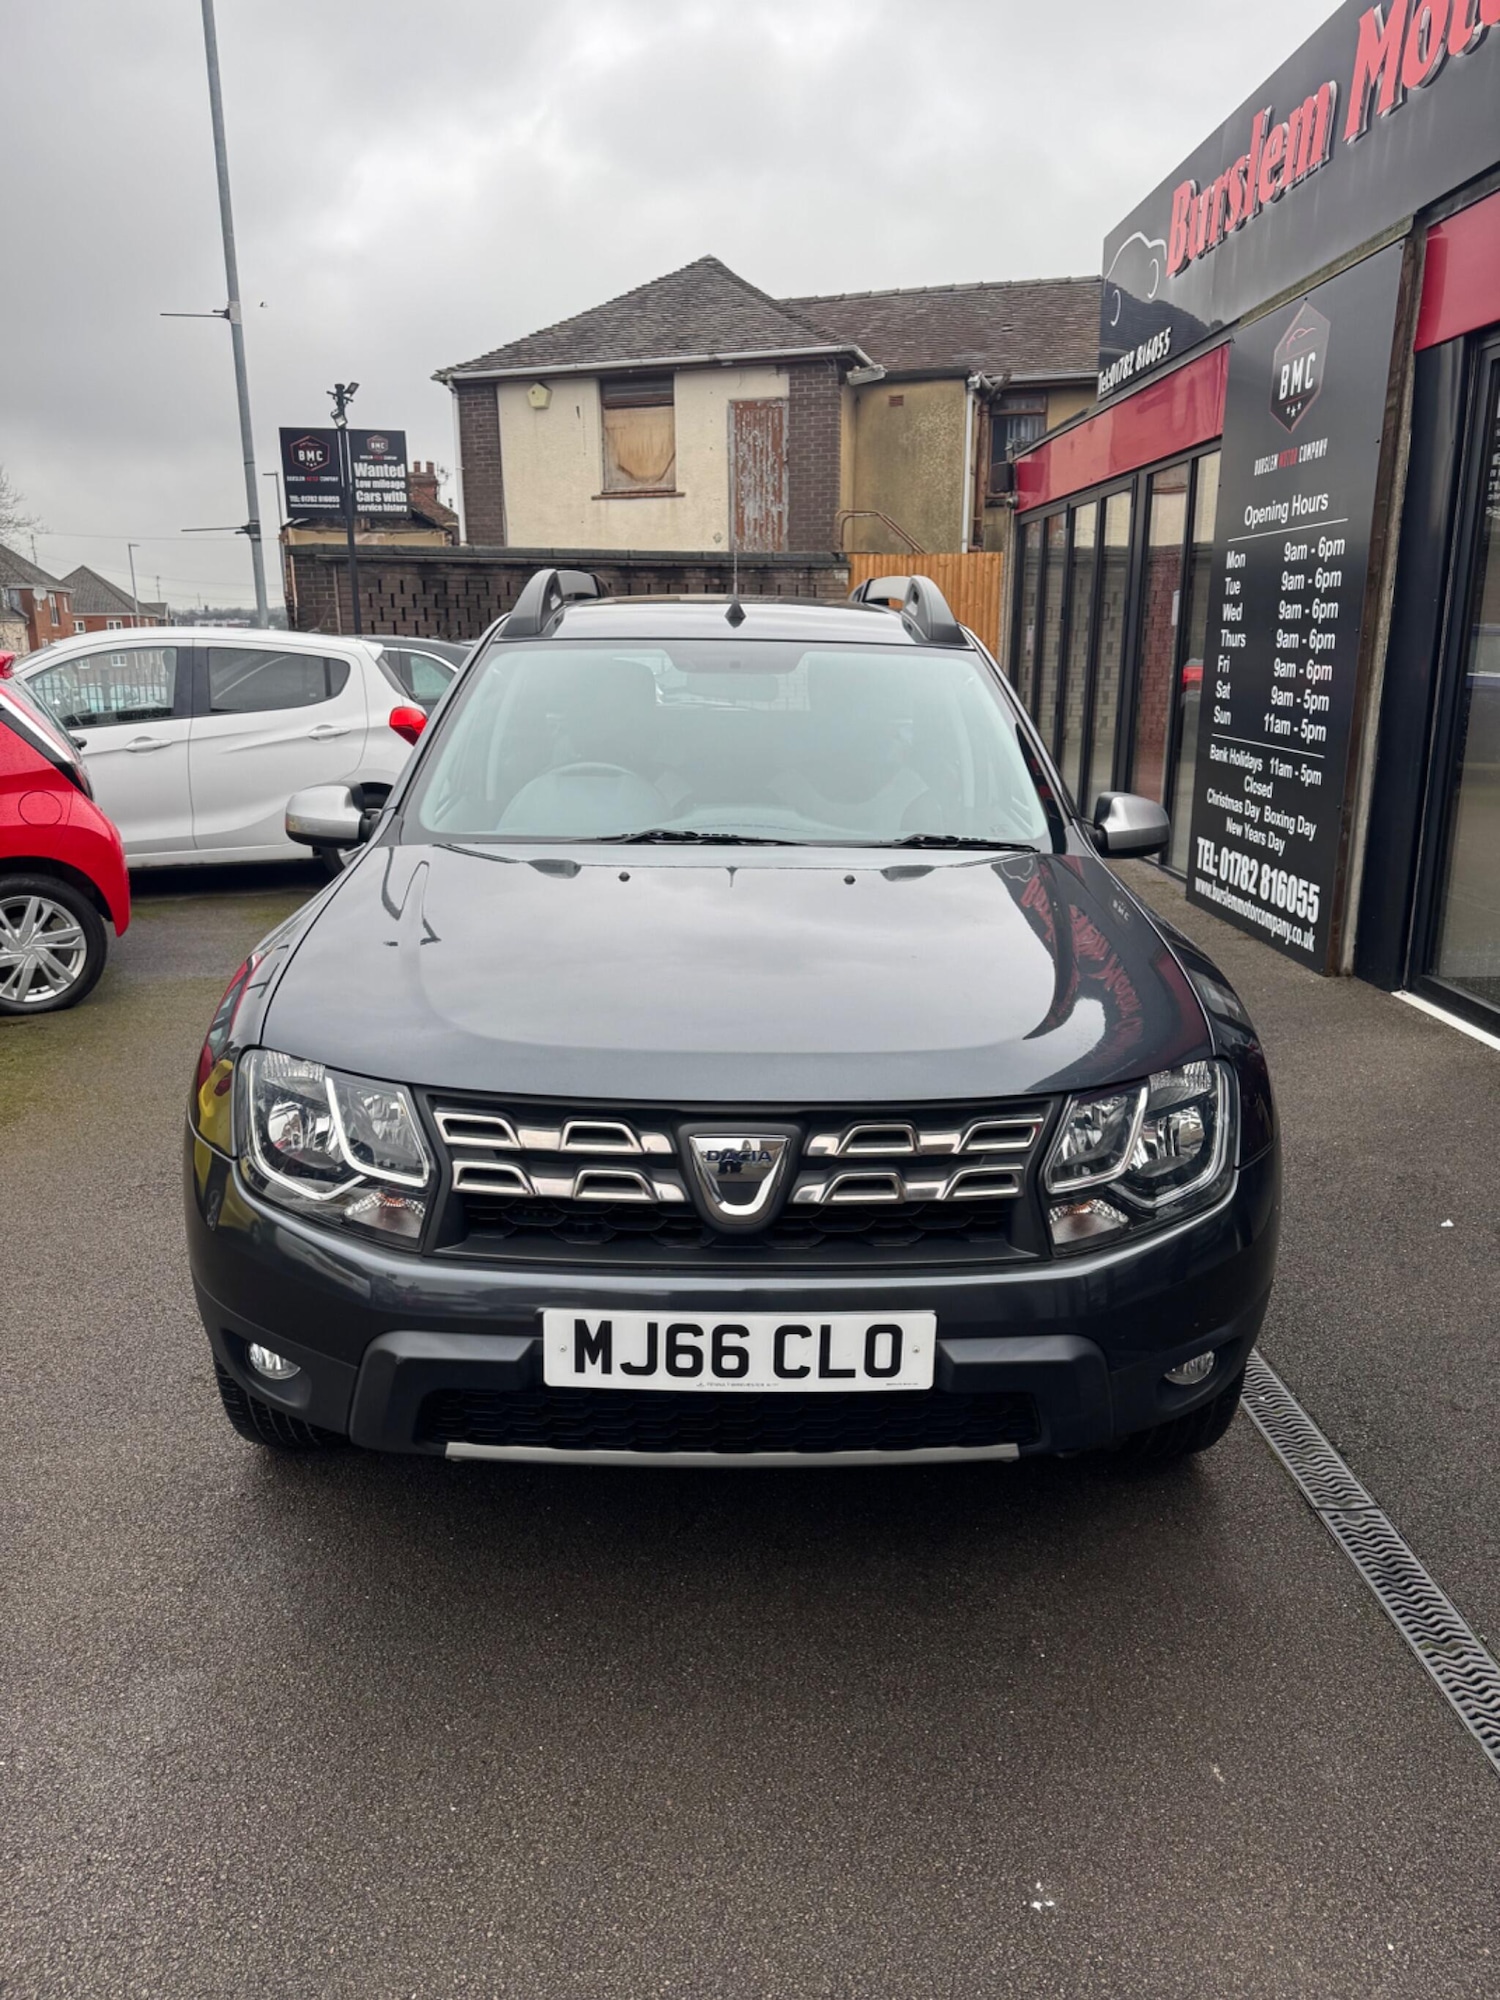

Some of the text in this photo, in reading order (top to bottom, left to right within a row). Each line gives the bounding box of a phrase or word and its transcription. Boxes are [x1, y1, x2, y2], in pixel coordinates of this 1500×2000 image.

[1166, 81, 1337, 278] Burslem
[1135, 326, 1171, 371] 816055
[1278, 352, 1317, 400] BMC
[298, 450, 323, 461] BMC
[1299, 437, 1328, 463] COMPANY
[354, 462, 405, 477] Wanted
[355, 479, 406, 490] Low mileage
[356, 490, 407, 502] Cars with
[357, 503, 407, 513] service history
[1244, 493, 1329, 529] Opening Hours
[1226, 551, 1246, 569] Mon
[1284, 542, 1307, 562] 9am
[1318, 536, 1345, 562] 6pm
[1225, 577, 1241, 595] Tue
[1281, 571, 1304, 591] 9am
[1315, 567, 1342, 593] 6pm
[1222, 603, 1242, 621] Wed
[1278, 600, 1301, 620] 9am
[1312, 598, 1339, 624] 6pm
[1220, 629, 1246, 648] Thurs
[1276, 629, 1298, 648] 9am
[1309, 629, 1336, 654] 6pm
[1217, 655, 1230, 673] Fri
[1274, 657, 1296, 678] 9am
[1306, 659, 1332, 685] 6pm
[1215, 680, 1231, 699] Sat
[1270, 686, 1293, 707] 9am
[1303, 689, 1329, 714] 5pm
[1213, 706, 1231, 726] Sun
[1264, 713, 1290, 736] 11am
[1301, 718, 1326, 744] 5pm
[1209, 744, 1228, 762] Bank
[1229, 746, 1263, 774] Holidays
[1270, 757, 1292, 779] 11am
[1300, 764, 1322, 787] 5pm
[1244, 775, 1273, 798] Closed
[1207, 788, 1317, 841] Christmas Day Boxing Day
[1226, 817, 1285, 856] New Years Day
[1197, 837, 1320, 924] TEL: 01782 816055
[1195, 877, 1315, 952] www.burslemmotorcompany.co.uk
[706, 1150, 772, 1162] DACIA
[574, 1318, 903, 1379] MJ66 CLO
